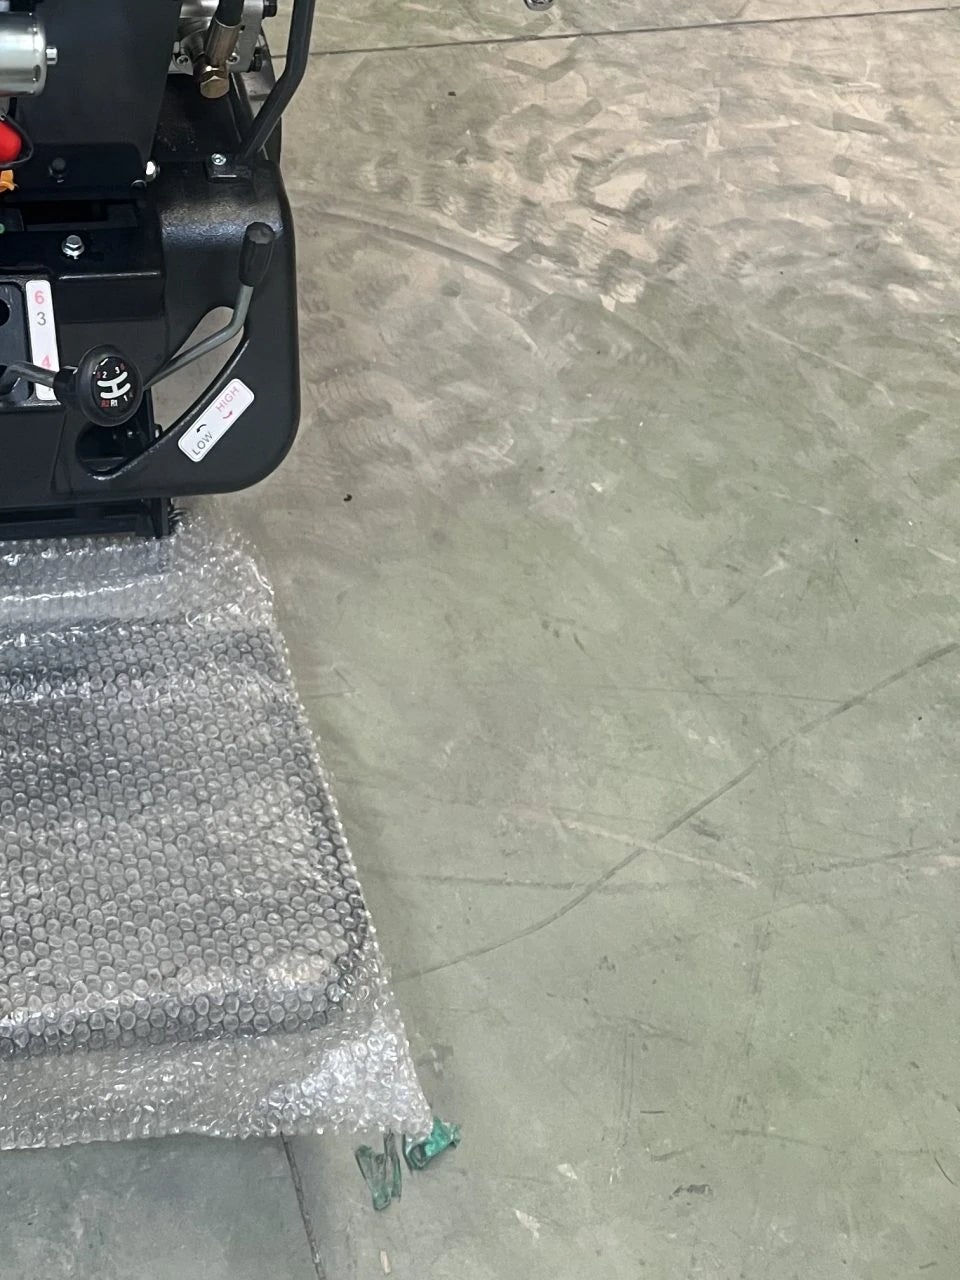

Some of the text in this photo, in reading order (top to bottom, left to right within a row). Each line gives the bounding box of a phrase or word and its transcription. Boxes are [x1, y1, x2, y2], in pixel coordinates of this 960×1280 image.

[34, 290, 45, 305] 6
[36, 311, 47, 326] 3
[41, 354, 52, 369] 4
[102, 371, 109, 379] 2
[114, 366, 121, 374] 3
[123, 394, 129, 402] 1
[214, 385, 240, 413] HIGH
[191, 431, 213, 457] LOW
